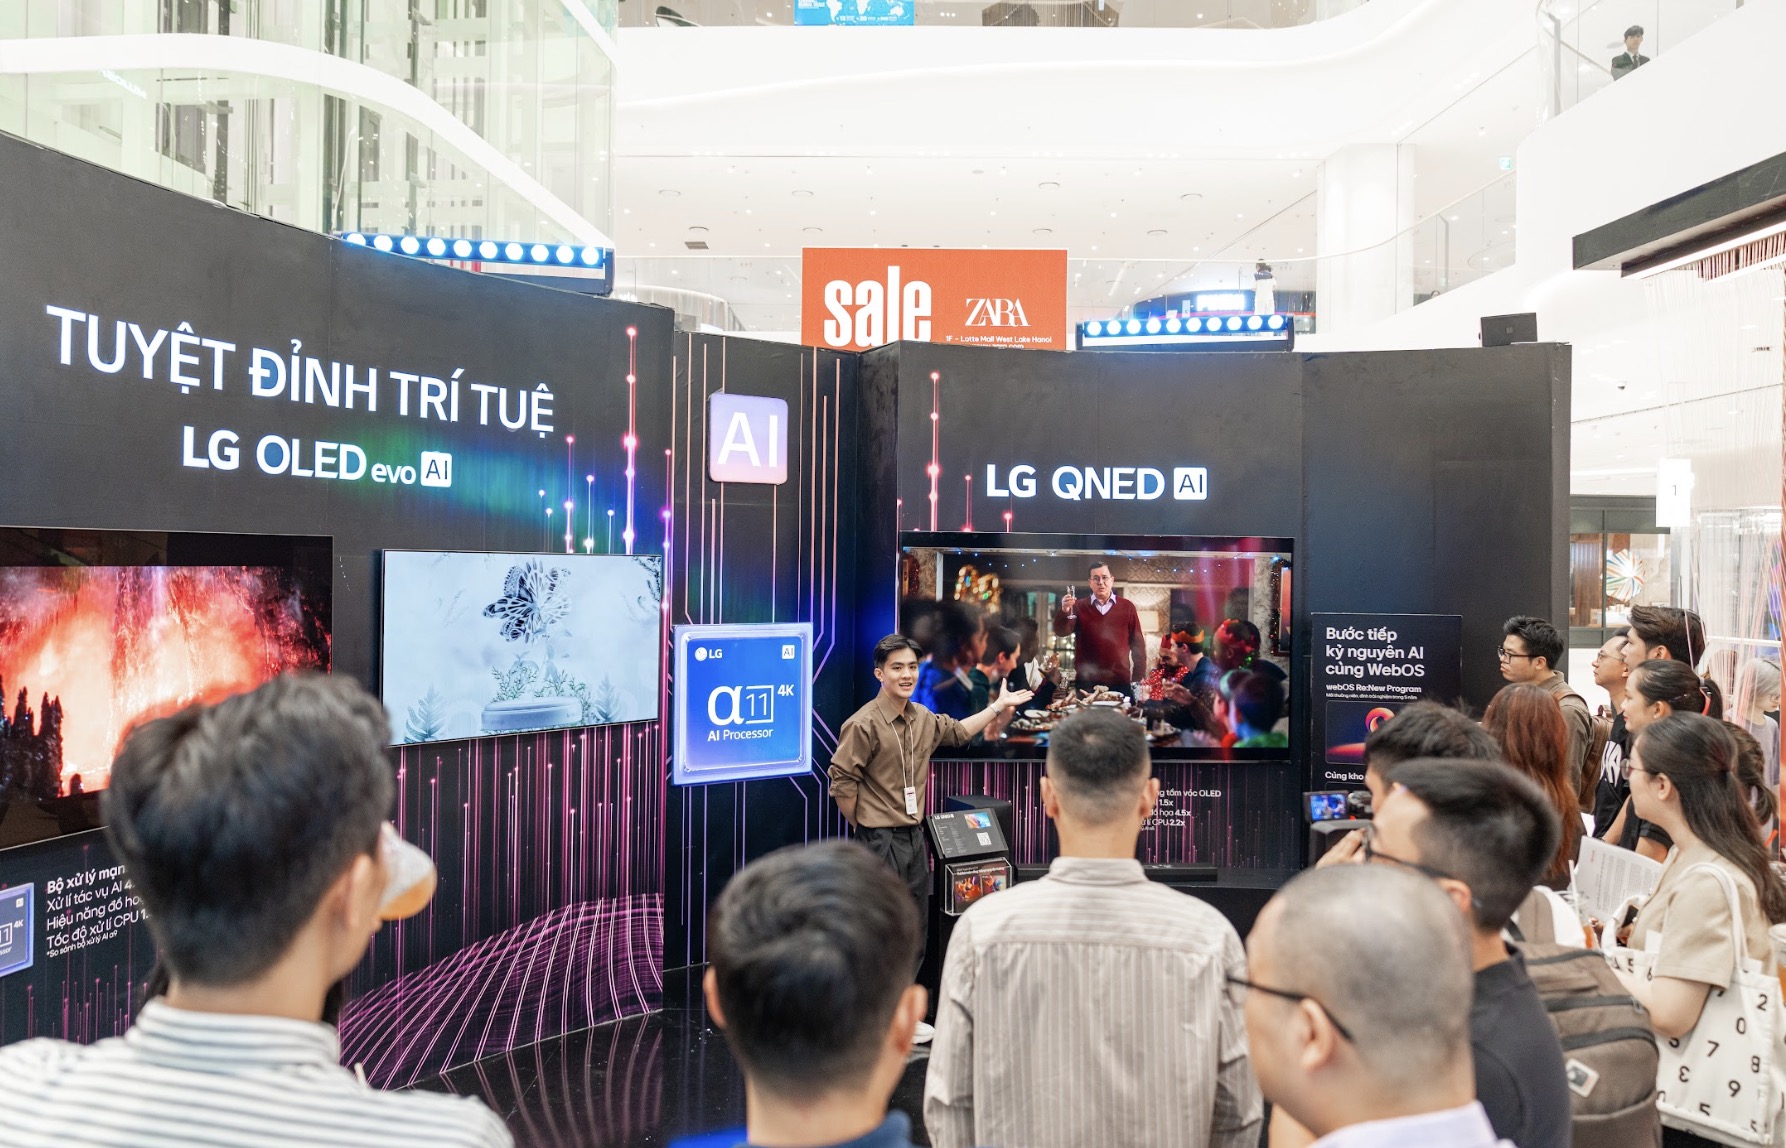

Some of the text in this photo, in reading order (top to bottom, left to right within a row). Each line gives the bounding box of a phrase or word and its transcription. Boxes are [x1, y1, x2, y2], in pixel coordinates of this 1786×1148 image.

[823, 266, 932, 347] sale
[964, 298, 1031, 327] ZARA
[46, 305, 554, 438] TUYỆT ĐỈNH TRÍ TUỆ
[716, 412, 778, 467] AI
[183, 425, 450, 485] LG OLED evo AI
[986, 463, 1205, 501] LG QNED AI
[1326, 626, 1397, 643] Bước tiếp
[708, 649, 723, 659] LG
[783, 646, 794, 658] AI
[1347, 646, 1405, 661] nguyên
[1408, 646, 1424, 659] AI
[1325, 661, 1425, 678] cùng WebOS
[777, 684, 794, 696] 4K
[1326, 683, 1355, 691] webOS
[1386, 686, 1422, 694] Program
[707, 728, 774, 741] AI Processor
[1199, 789, 1222, 798] OLED
[47, 864, 126, 895] Bộ xử lý mạn
[47, 897, 63, 913] Xử
[74, 890, 93, 905] tác
[95, 886, 109, 899] vụ
[110, 880, 122, 895] AI
[14, 918, 24, 929] 4K
[47, 913, 74, 931] Hiệu
[76, 905, 105, 922] năng
[47, 931, 70, 949] Tốc
[89, 920, 105, 936] xử
[113, 910, 139, 928] CPU
[1757, 993, 1768, 1011] 2
[1707, 1040, 1719, 1057] 7
[1752, 1055, 1760, 1073] 8
